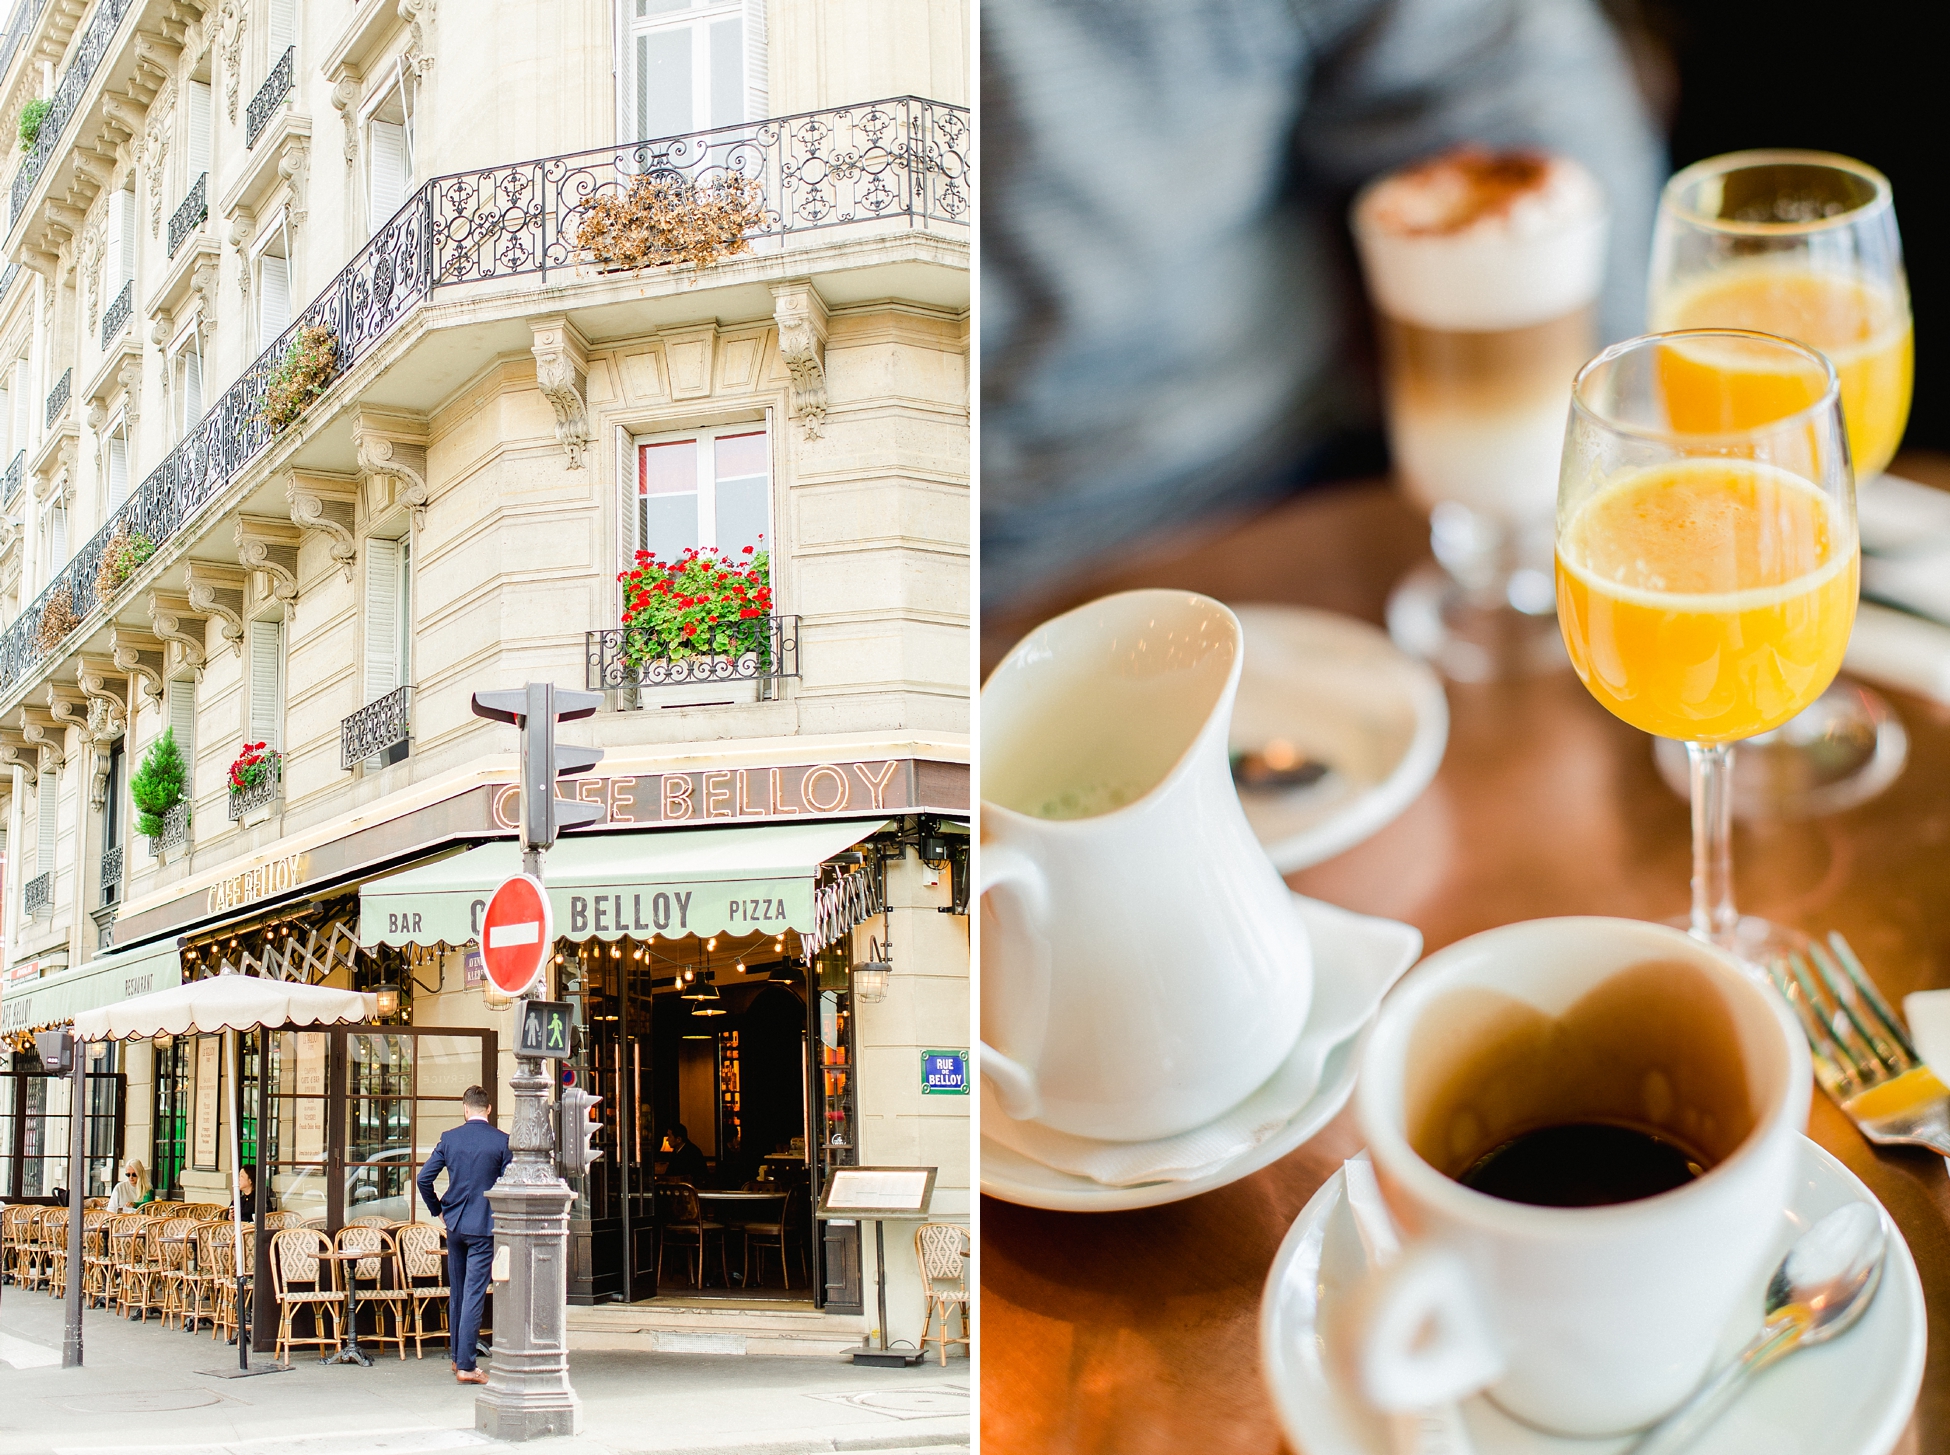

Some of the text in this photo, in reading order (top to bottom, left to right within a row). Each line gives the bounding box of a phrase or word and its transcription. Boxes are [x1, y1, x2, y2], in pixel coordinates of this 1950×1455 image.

[493, 760, 898, 830] CFE BELLOY
[244, 854, 301, 902] BELLOY
[570, 891, 693, 933] BELLOY
[729, 898, 787, 922] PIZZA
[388, 912, 423, 934] BAR
[936, 1058, 954, 1070] RUE
[928, 1074, 962, 1086] BELLOY
